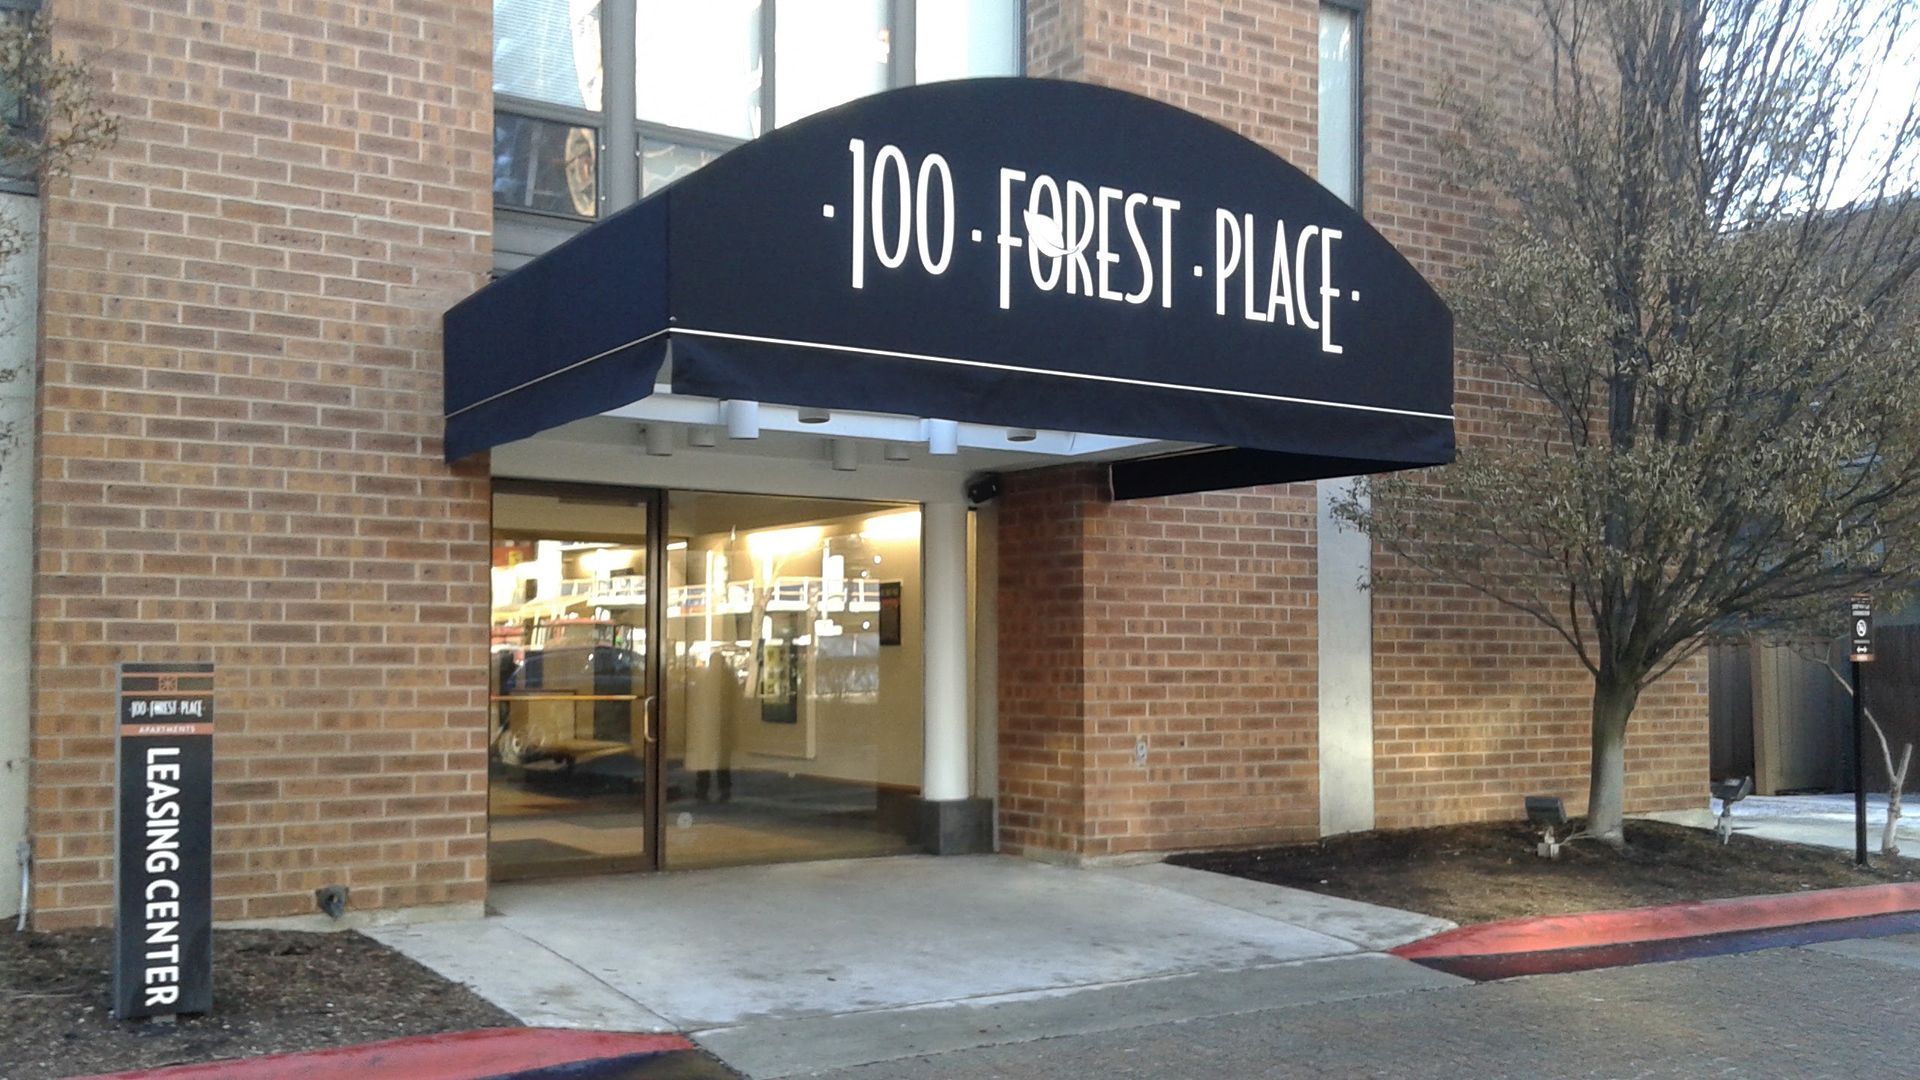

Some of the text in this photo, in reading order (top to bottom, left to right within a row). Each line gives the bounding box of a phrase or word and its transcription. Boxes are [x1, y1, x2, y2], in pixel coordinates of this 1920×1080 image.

[849, 138, 1343, 354] 100 FOREST PLACE
[139, 725, 196, 734] APARTMENTS
[145, 747, 180, 1007] LEASING CENTER
